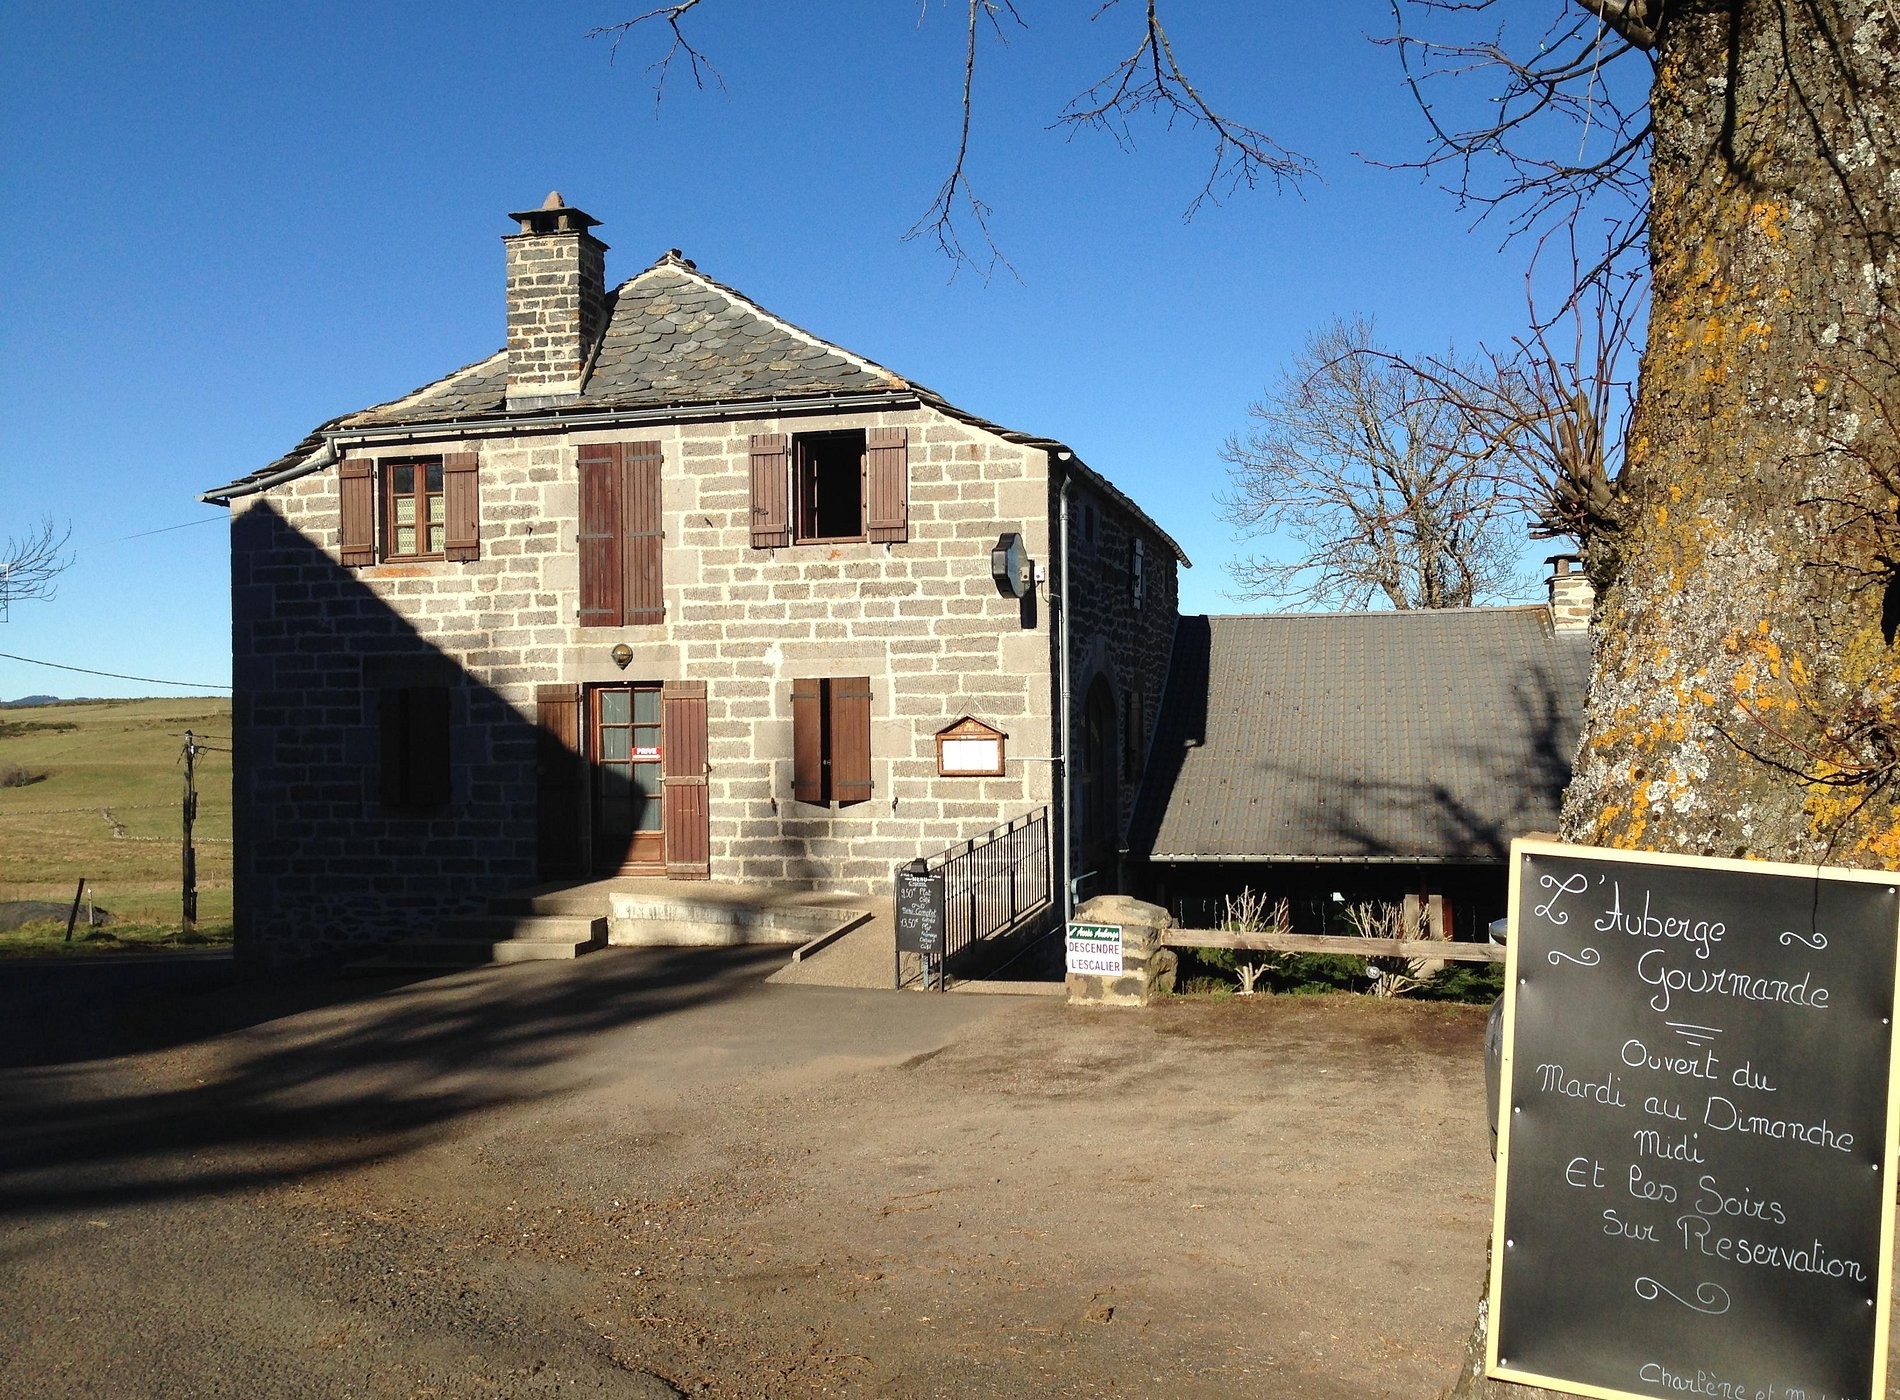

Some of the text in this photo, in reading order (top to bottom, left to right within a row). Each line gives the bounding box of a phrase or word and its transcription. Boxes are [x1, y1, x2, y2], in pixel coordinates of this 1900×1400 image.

[1534, 873, 1726, 959] L'Auberge
[1069, 942, 1120, 955] DESCENDRE
[1071, 959, 1121, 972] L'ESCALIER
[1638, 949, 1829, 1012] Gourmande
[1621, 1039, 1777, 1091] Ouvert du
[1536, 1063, 1854, 1152] Mardi au Dimanche
[1633, 1128, 1704, 1163] Midi
[1565, 1157, 1786, 1225] Et les Soirs
[1603, 1209, 1867, 1283] Sur Reservation
[1639, 1363, 1746, 1400] Charlène
